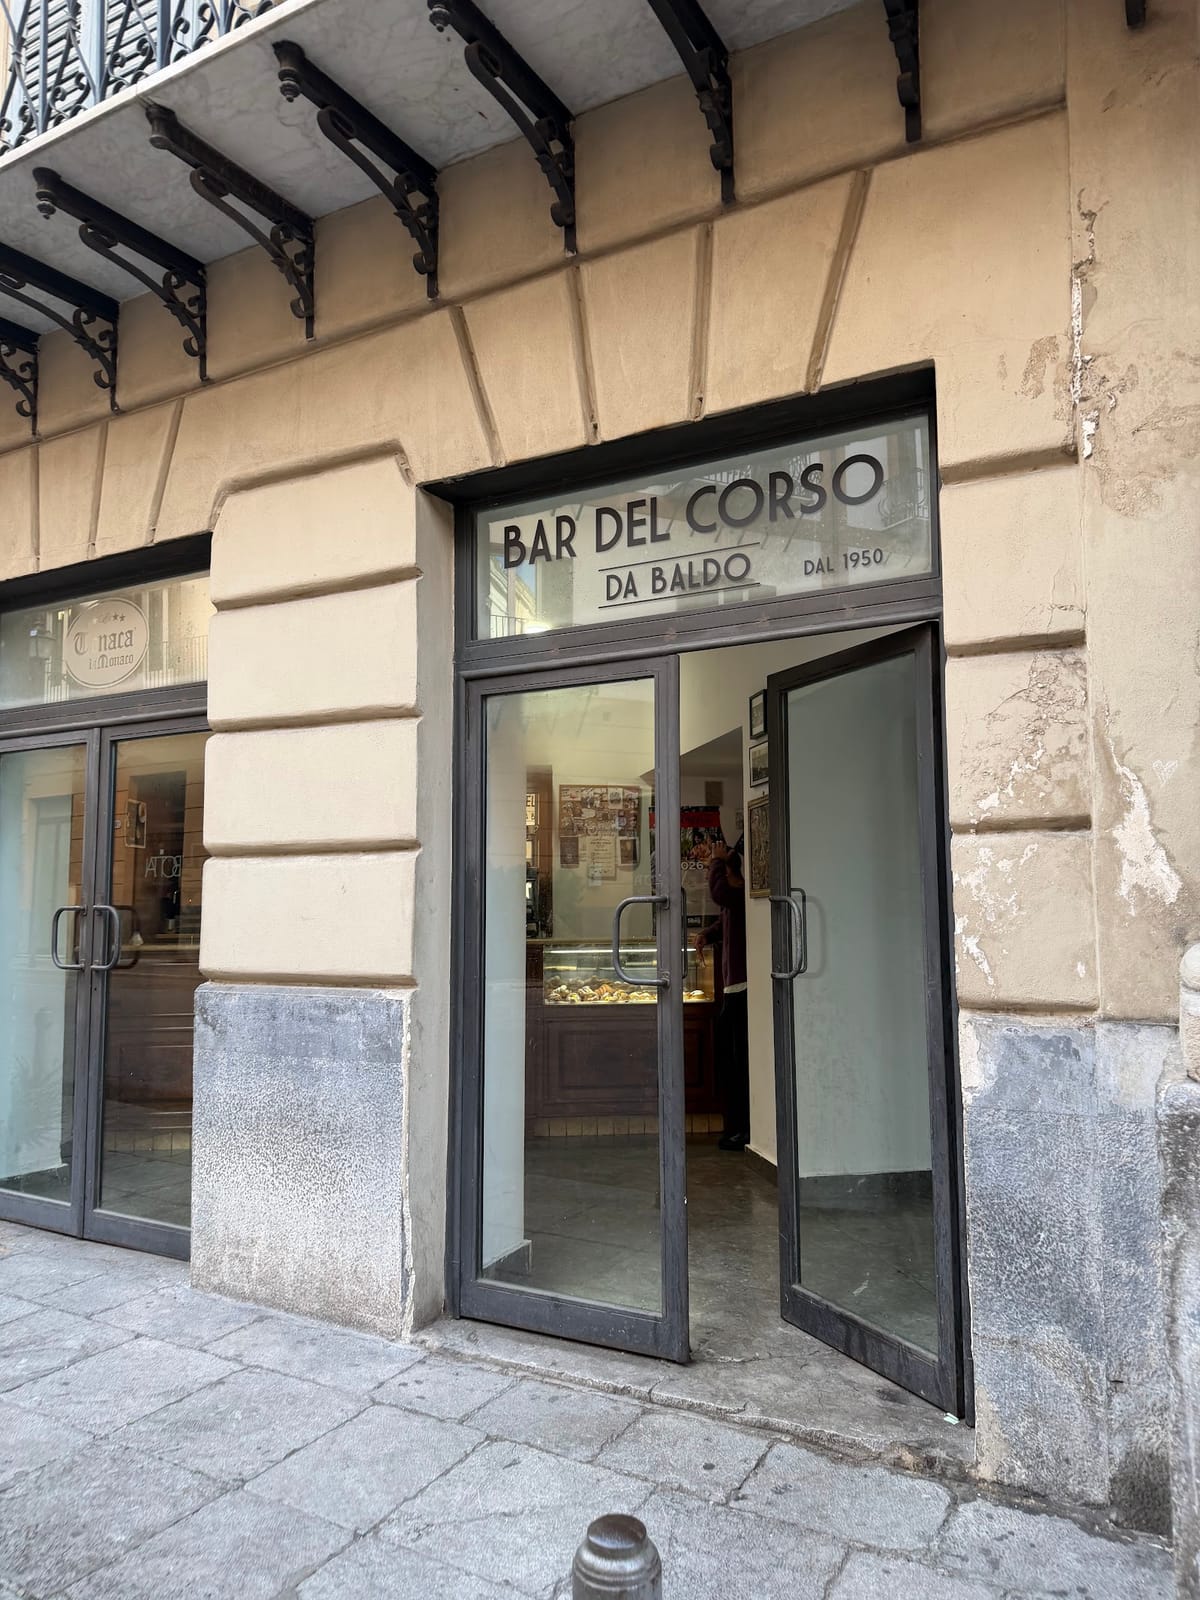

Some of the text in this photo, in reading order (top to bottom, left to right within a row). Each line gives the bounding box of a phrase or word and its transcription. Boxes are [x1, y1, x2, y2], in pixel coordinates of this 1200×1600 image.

[503, 453, 885, 570] BAR DEL CORSO
[803, 547, 884, 576] DAL 1950
[606, 552, 752, 601] DA BALDO
[73, 629, 135, 655] Tnaca
[97, 653, 134, 670] Monaco
[681, 861, 704, 870] 026
